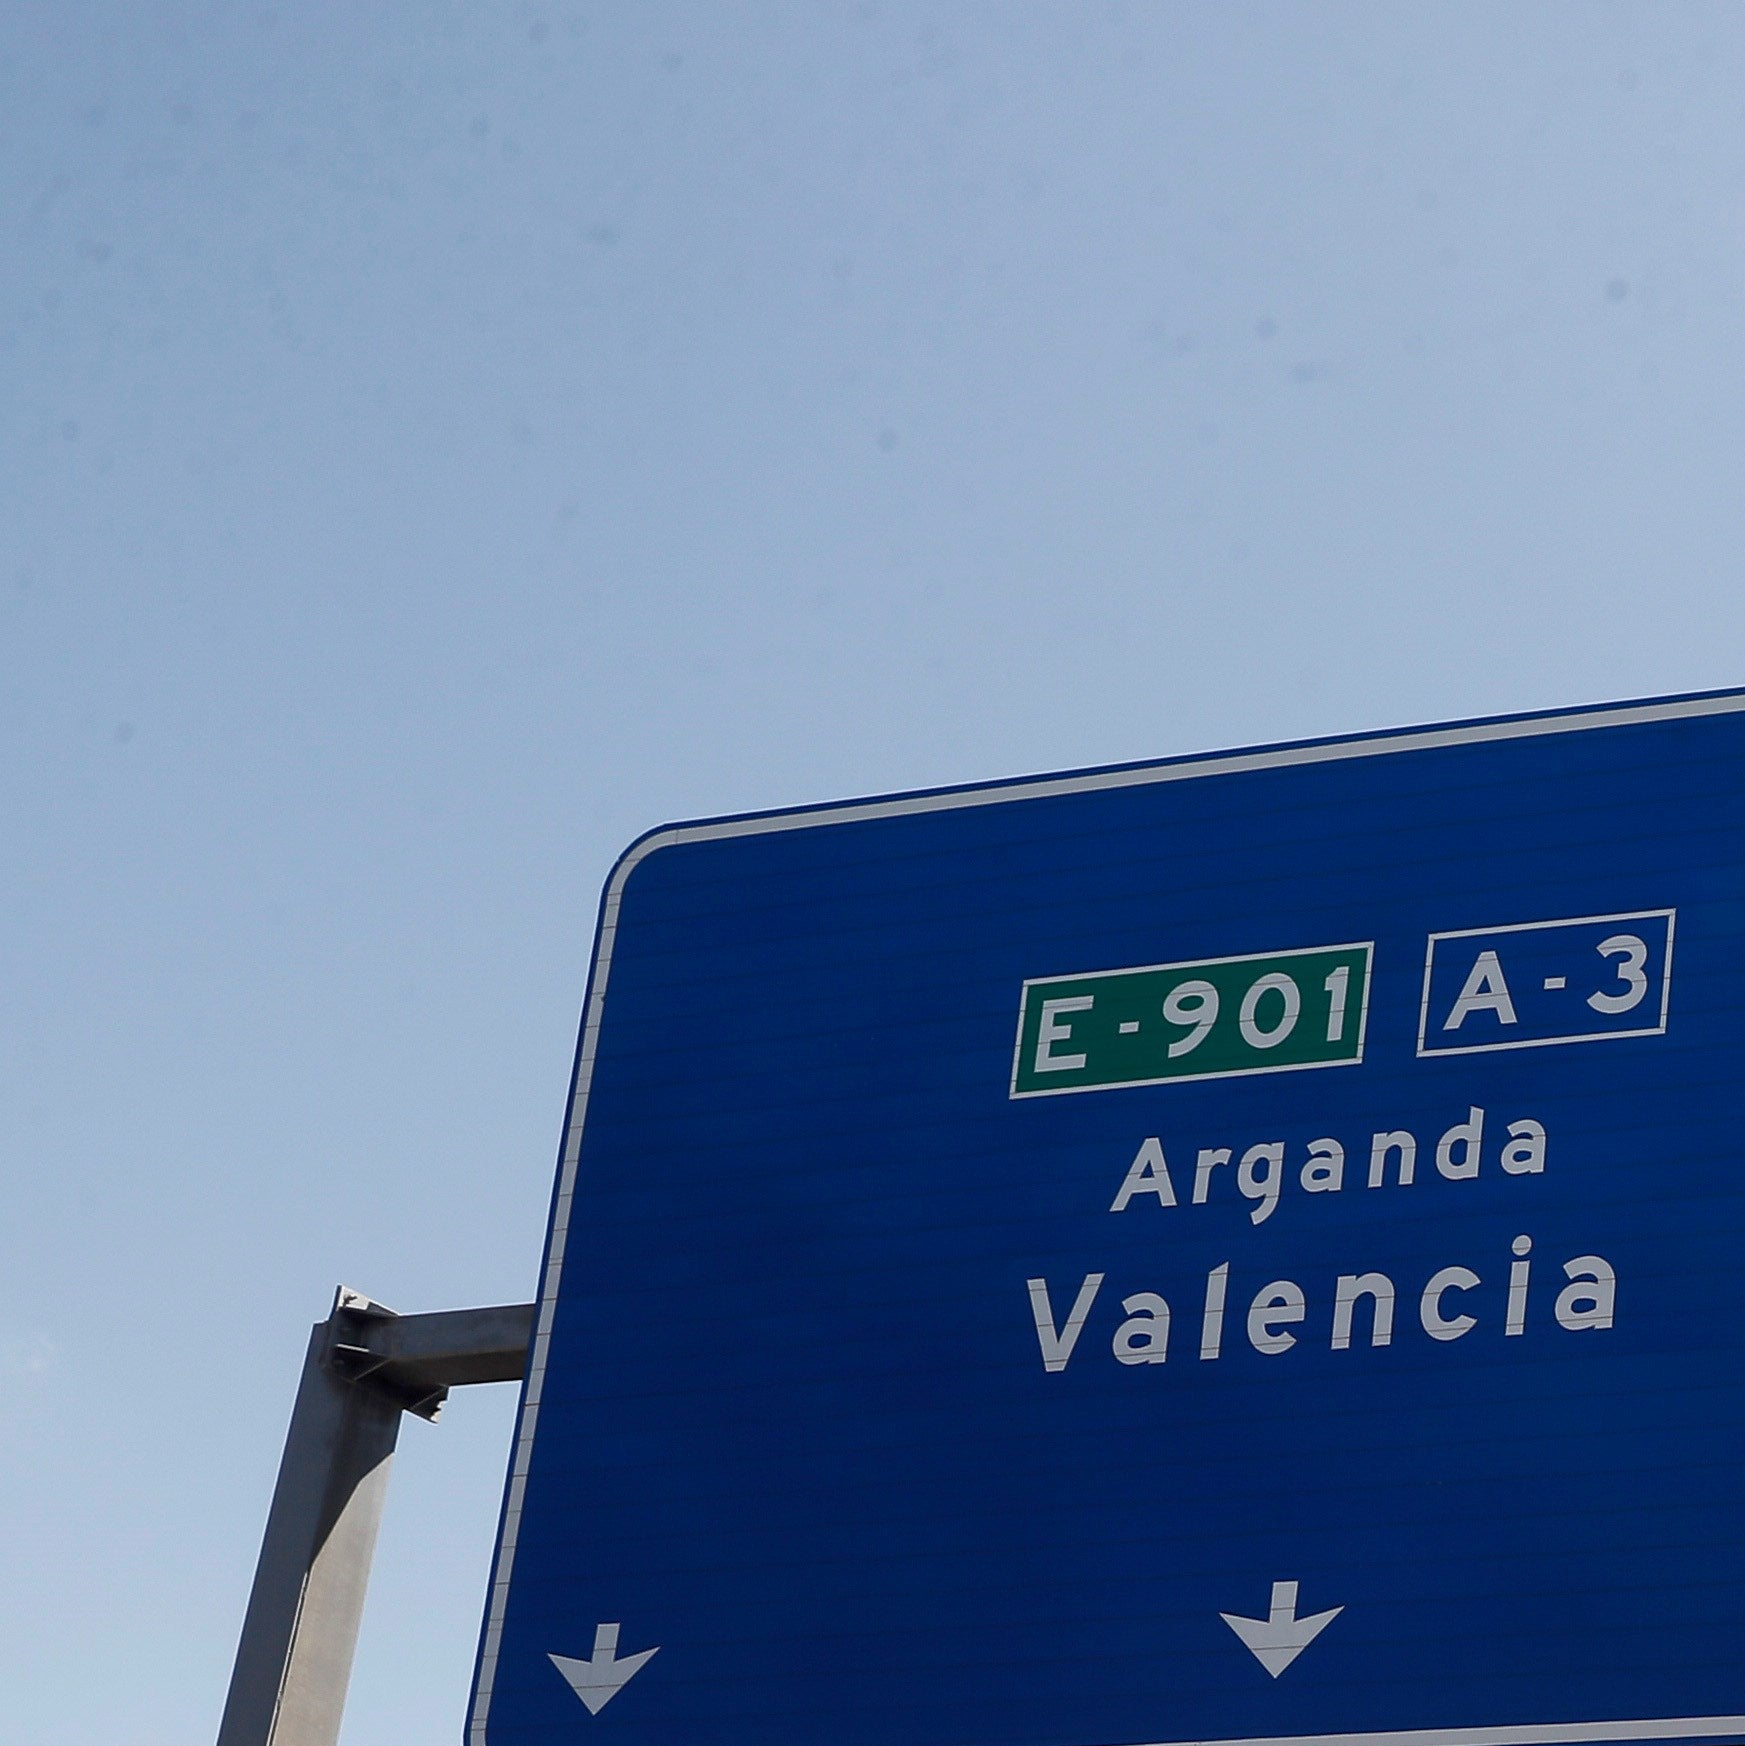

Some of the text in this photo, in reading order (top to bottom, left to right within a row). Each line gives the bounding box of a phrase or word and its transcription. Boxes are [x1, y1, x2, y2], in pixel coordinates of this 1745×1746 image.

[1033, 965, 1351, 1073] E-901
[1442, 934, 1649, 1031] A-3
[1109, 1105, 1547, 1225] Arganda
[1026, 1234, 1616, 1373] Valencia
